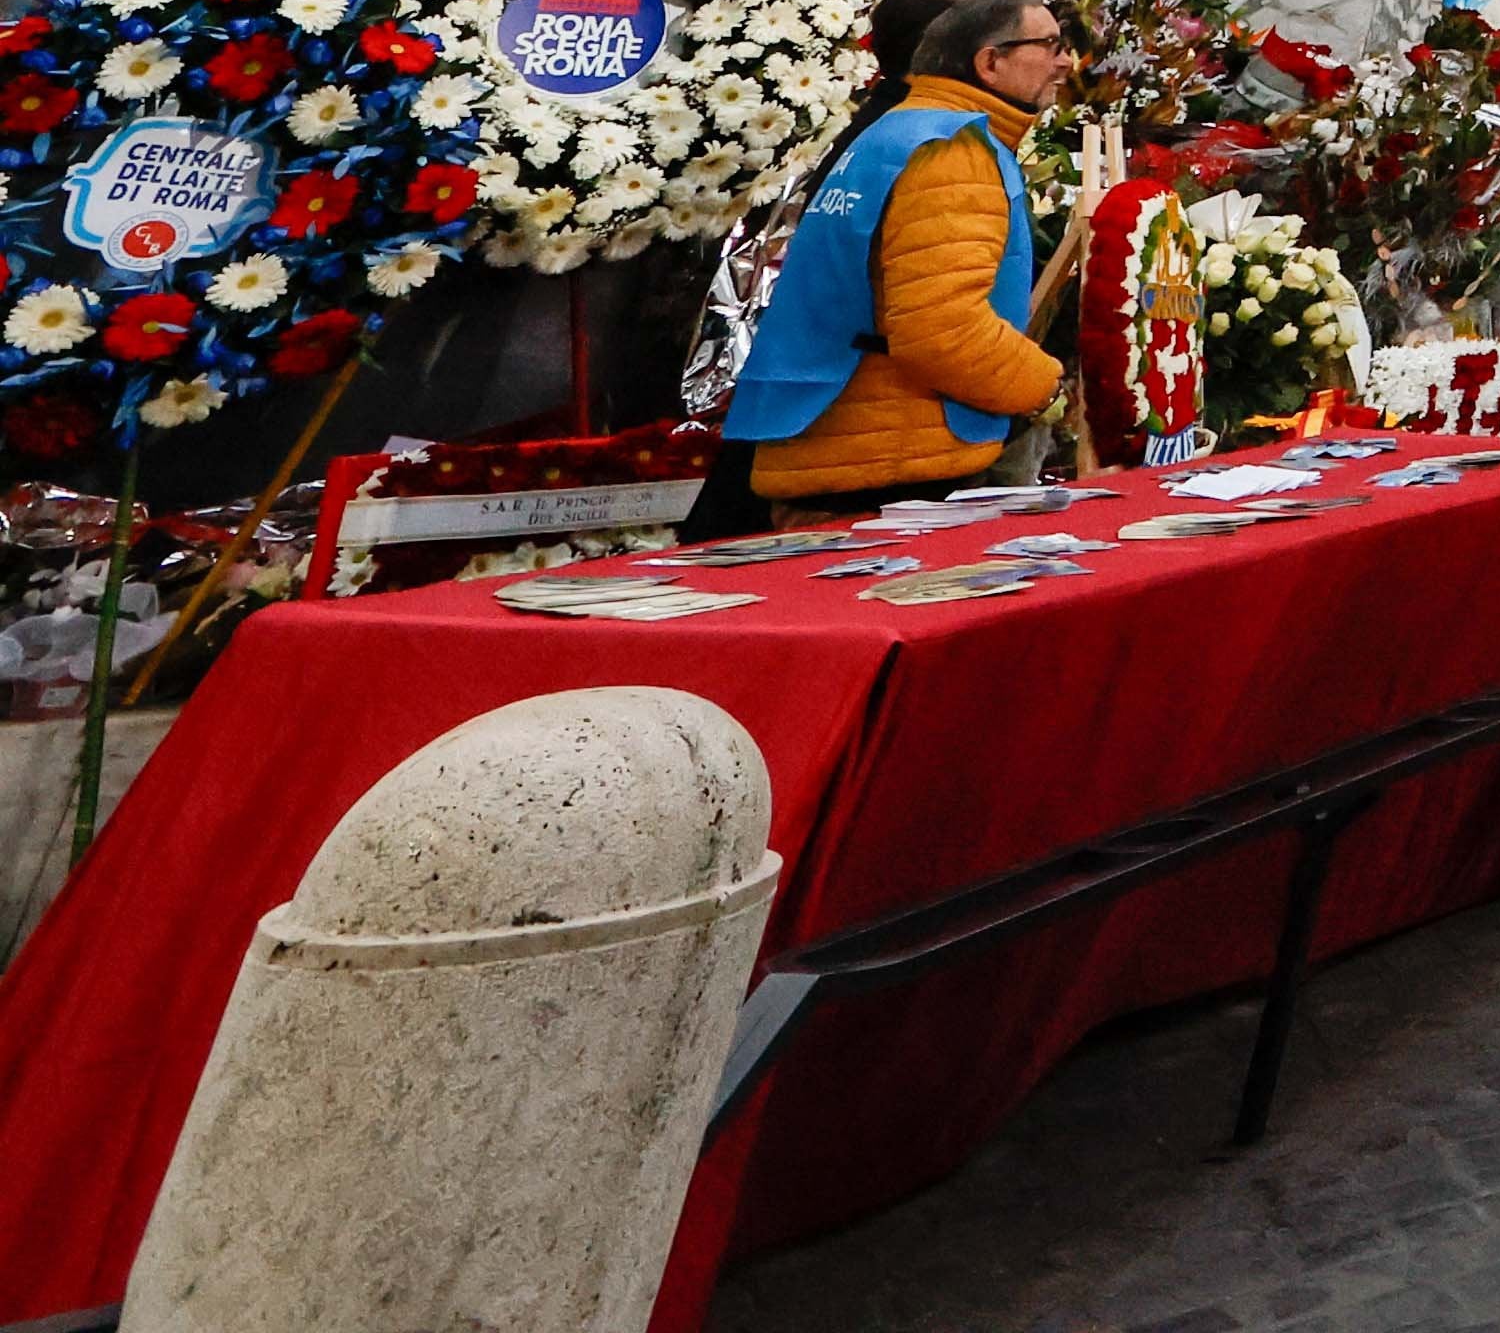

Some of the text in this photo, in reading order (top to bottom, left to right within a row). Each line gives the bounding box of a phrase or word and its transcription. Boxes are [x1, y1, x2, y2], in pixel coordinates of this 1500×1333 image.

[532, 13, 635, 39] ROMA
[512, 33, 645, 59] SCEGLIE
[523, 52, 627, 78] ROMA
[128, 143, 257, 173] CENTRALE
[118, 163, 247, 193] DEL LATTE
[107, 184, 229, 213] DI ROMA
